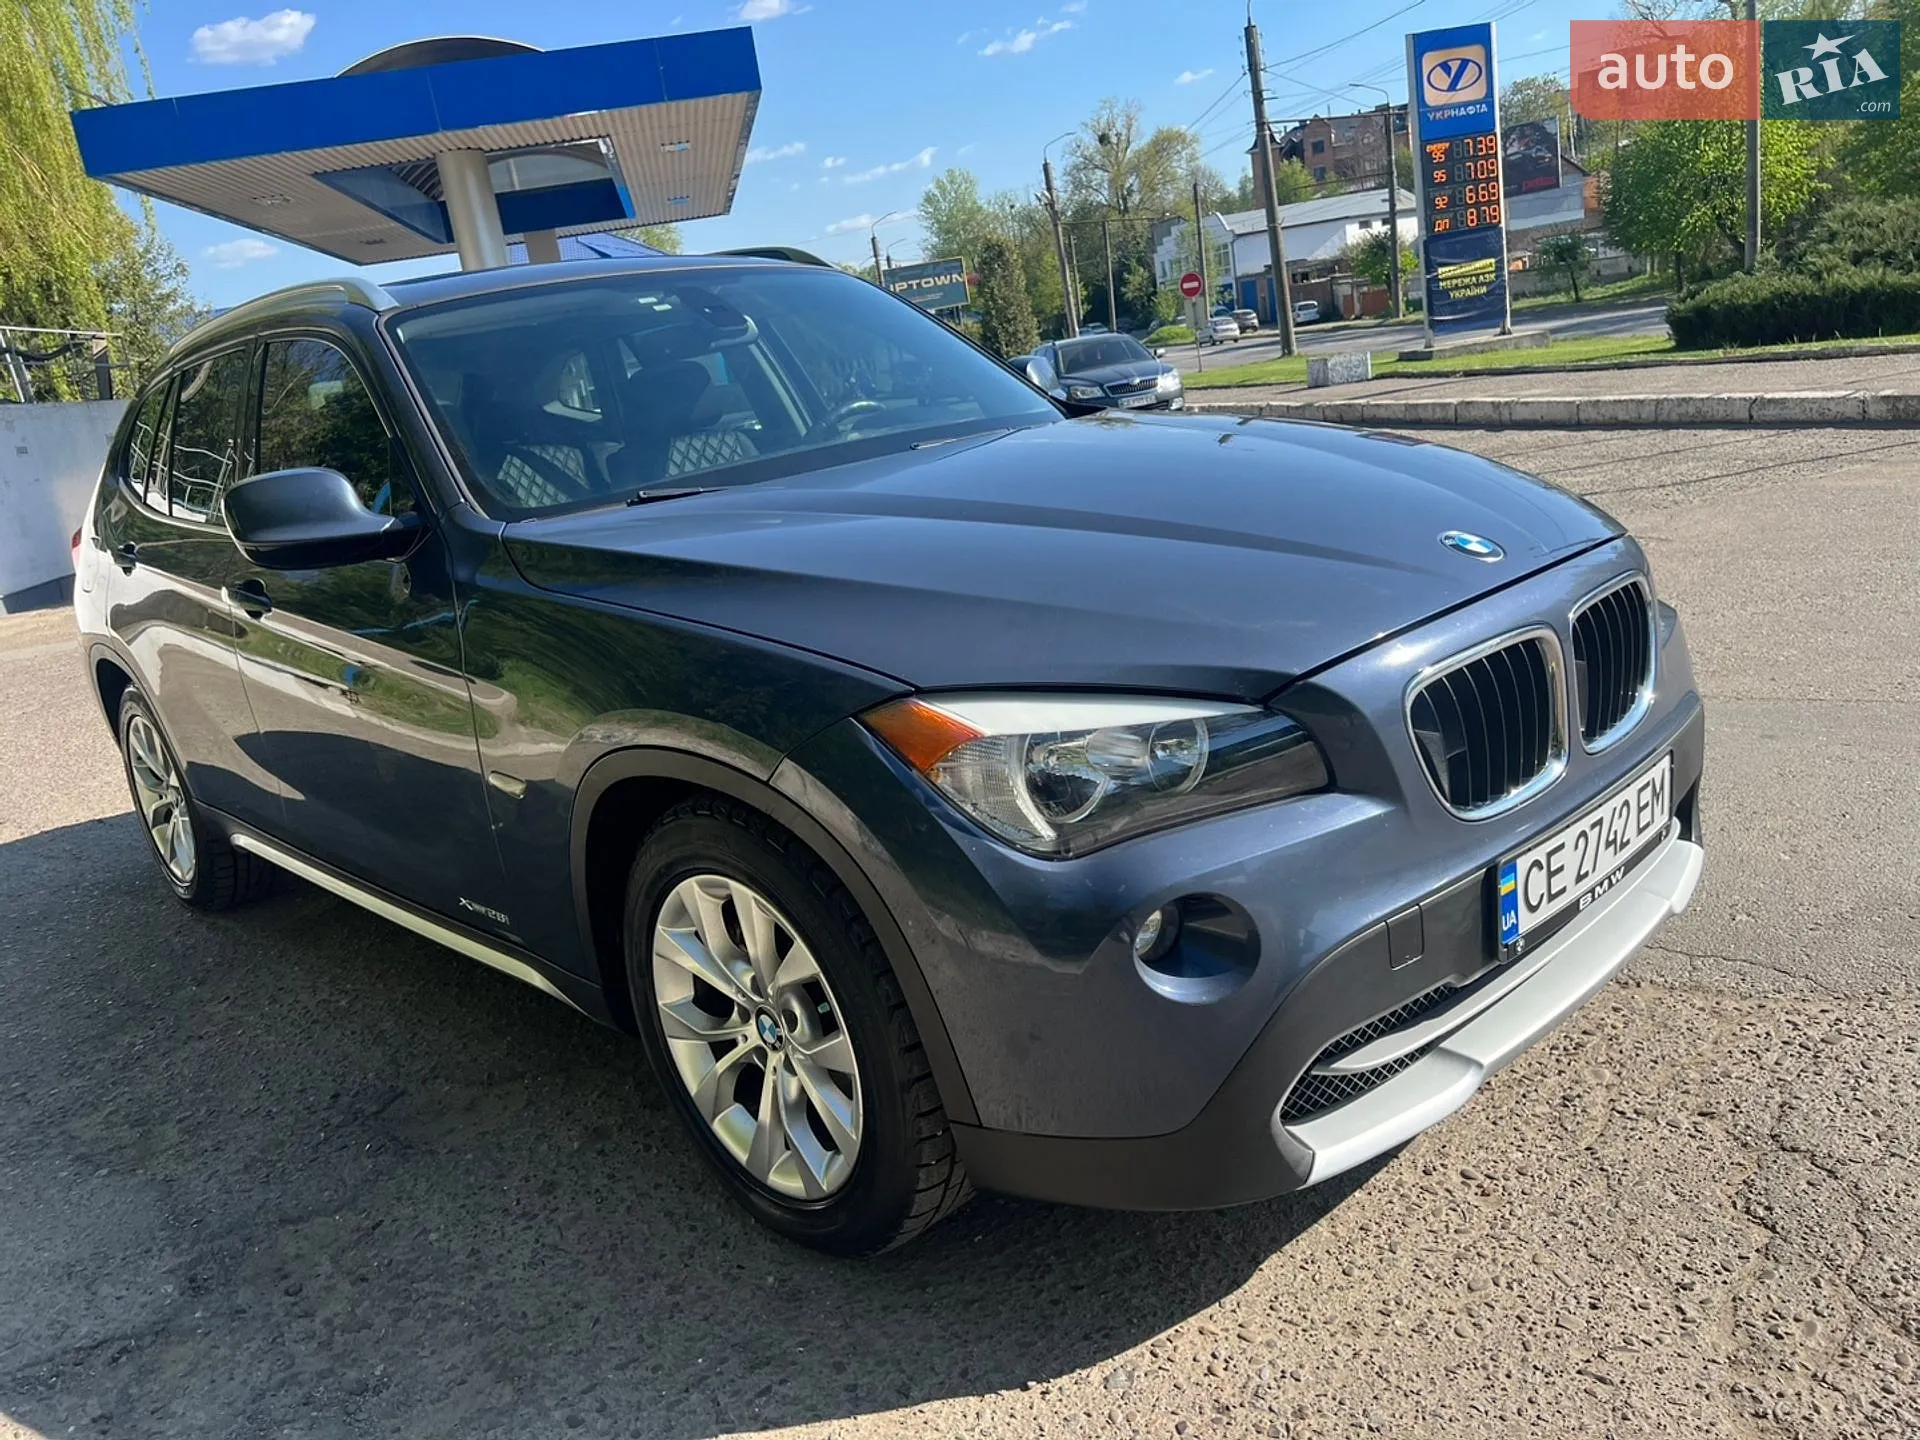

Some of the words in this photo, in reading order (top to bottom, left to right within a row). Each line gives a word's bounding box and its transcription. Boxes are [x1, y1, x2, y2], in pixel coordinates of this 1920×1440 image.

[1426, 103, 1488, 121] УКРНАФТА
[1433, 169, 1447, 183] 95
[1434, 196, 1448, 209] 92
[1439, 276, 1477, 289] МЕРЕЖА
[1478, 272, 1496, 283] АЗК
[1449, 286, 1487, 299] УКРАЇНИ
[1524, 842, 1567, 914] CE
[1575, 799, 1631, 885] 2742
[1637, 768, 1665, 837] EM
[1578, 866, 1625, 911] BMW
[1502, 911, 1517, 931] UA
